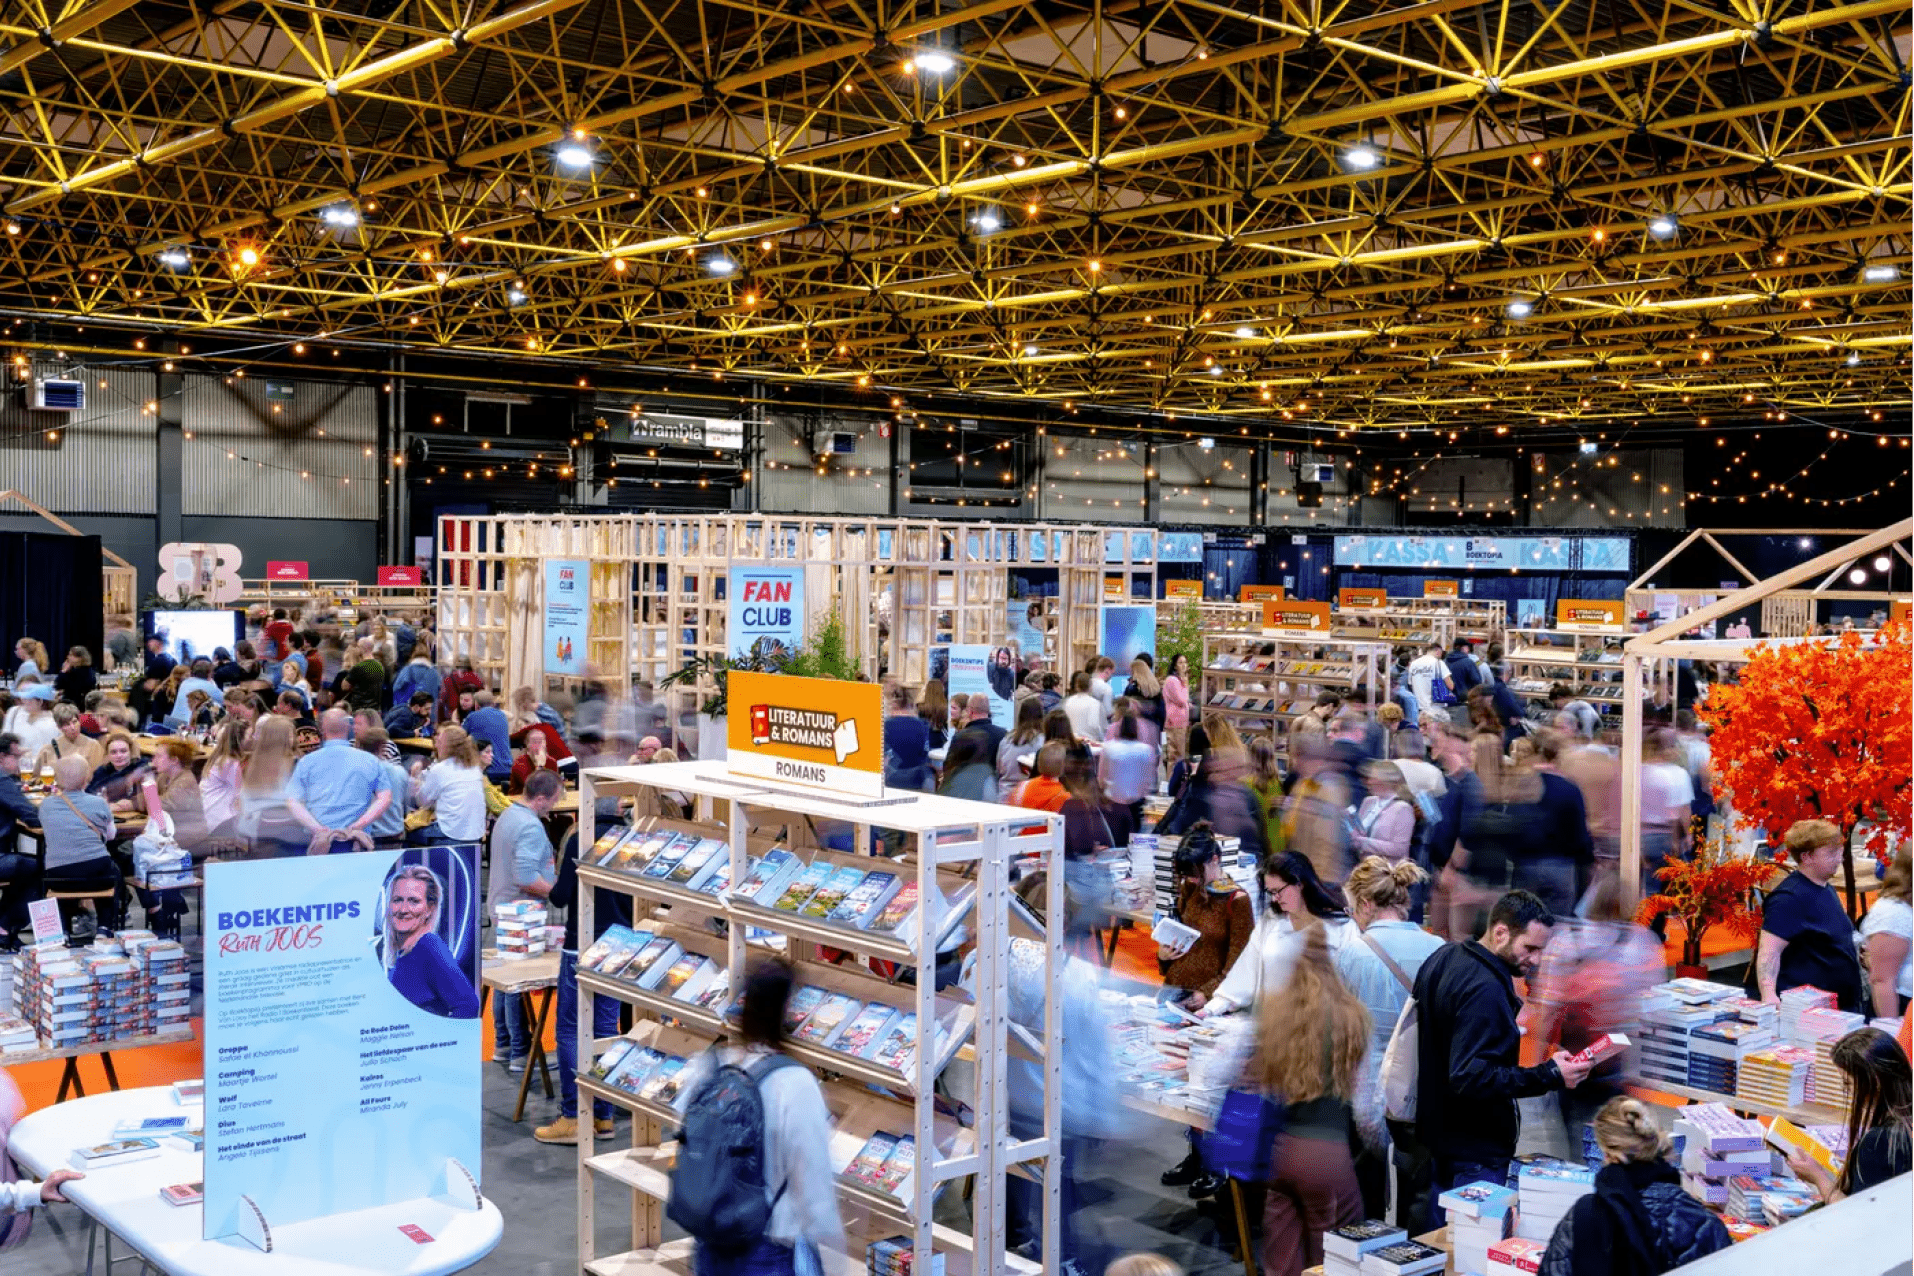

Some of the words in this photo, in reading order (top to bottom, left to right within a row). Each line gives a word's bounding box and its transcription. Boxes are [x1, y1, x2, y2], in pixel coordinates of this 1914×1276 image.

[650, 424, 702, 440] rambla
[1368, 541, 1449, 564] KASSA
[743, 581, 792, 602] FAN
[742, 607, 792, 626] CLUB
[768, 707, 836, 730] LITERATUUR
[771, 728, 780, 740] &
[782, 728, 833, 747] ROMANS
[776, 761, 826, 783] ROMANS
[218, 900, 360, 930] BOEKENTIPS
[360, 1034, 388, 1044] Maggie
[390, 1031, 414, 1039] Nelson
[218, 1068, 255, 1079] Camping
[218, 1078, 250, 1087] Maartje
[360, 1082, 383, 1090] Jenny
[218, 1094, 238, 1103] Wolf
[218, 1104, 236, 1112] Lara
[360, 1104, 390, 1113] Miranda
[393, 1101, 408, 1109] July
[218, 1120, 236, 1128] Dius
[218, 1128, 244, 1137] Stefan
[246, 1121, 285, 1133] Hertmans
[233, 1141, 255, 1150] einde
[283, 1132, 306, 1142] straat
